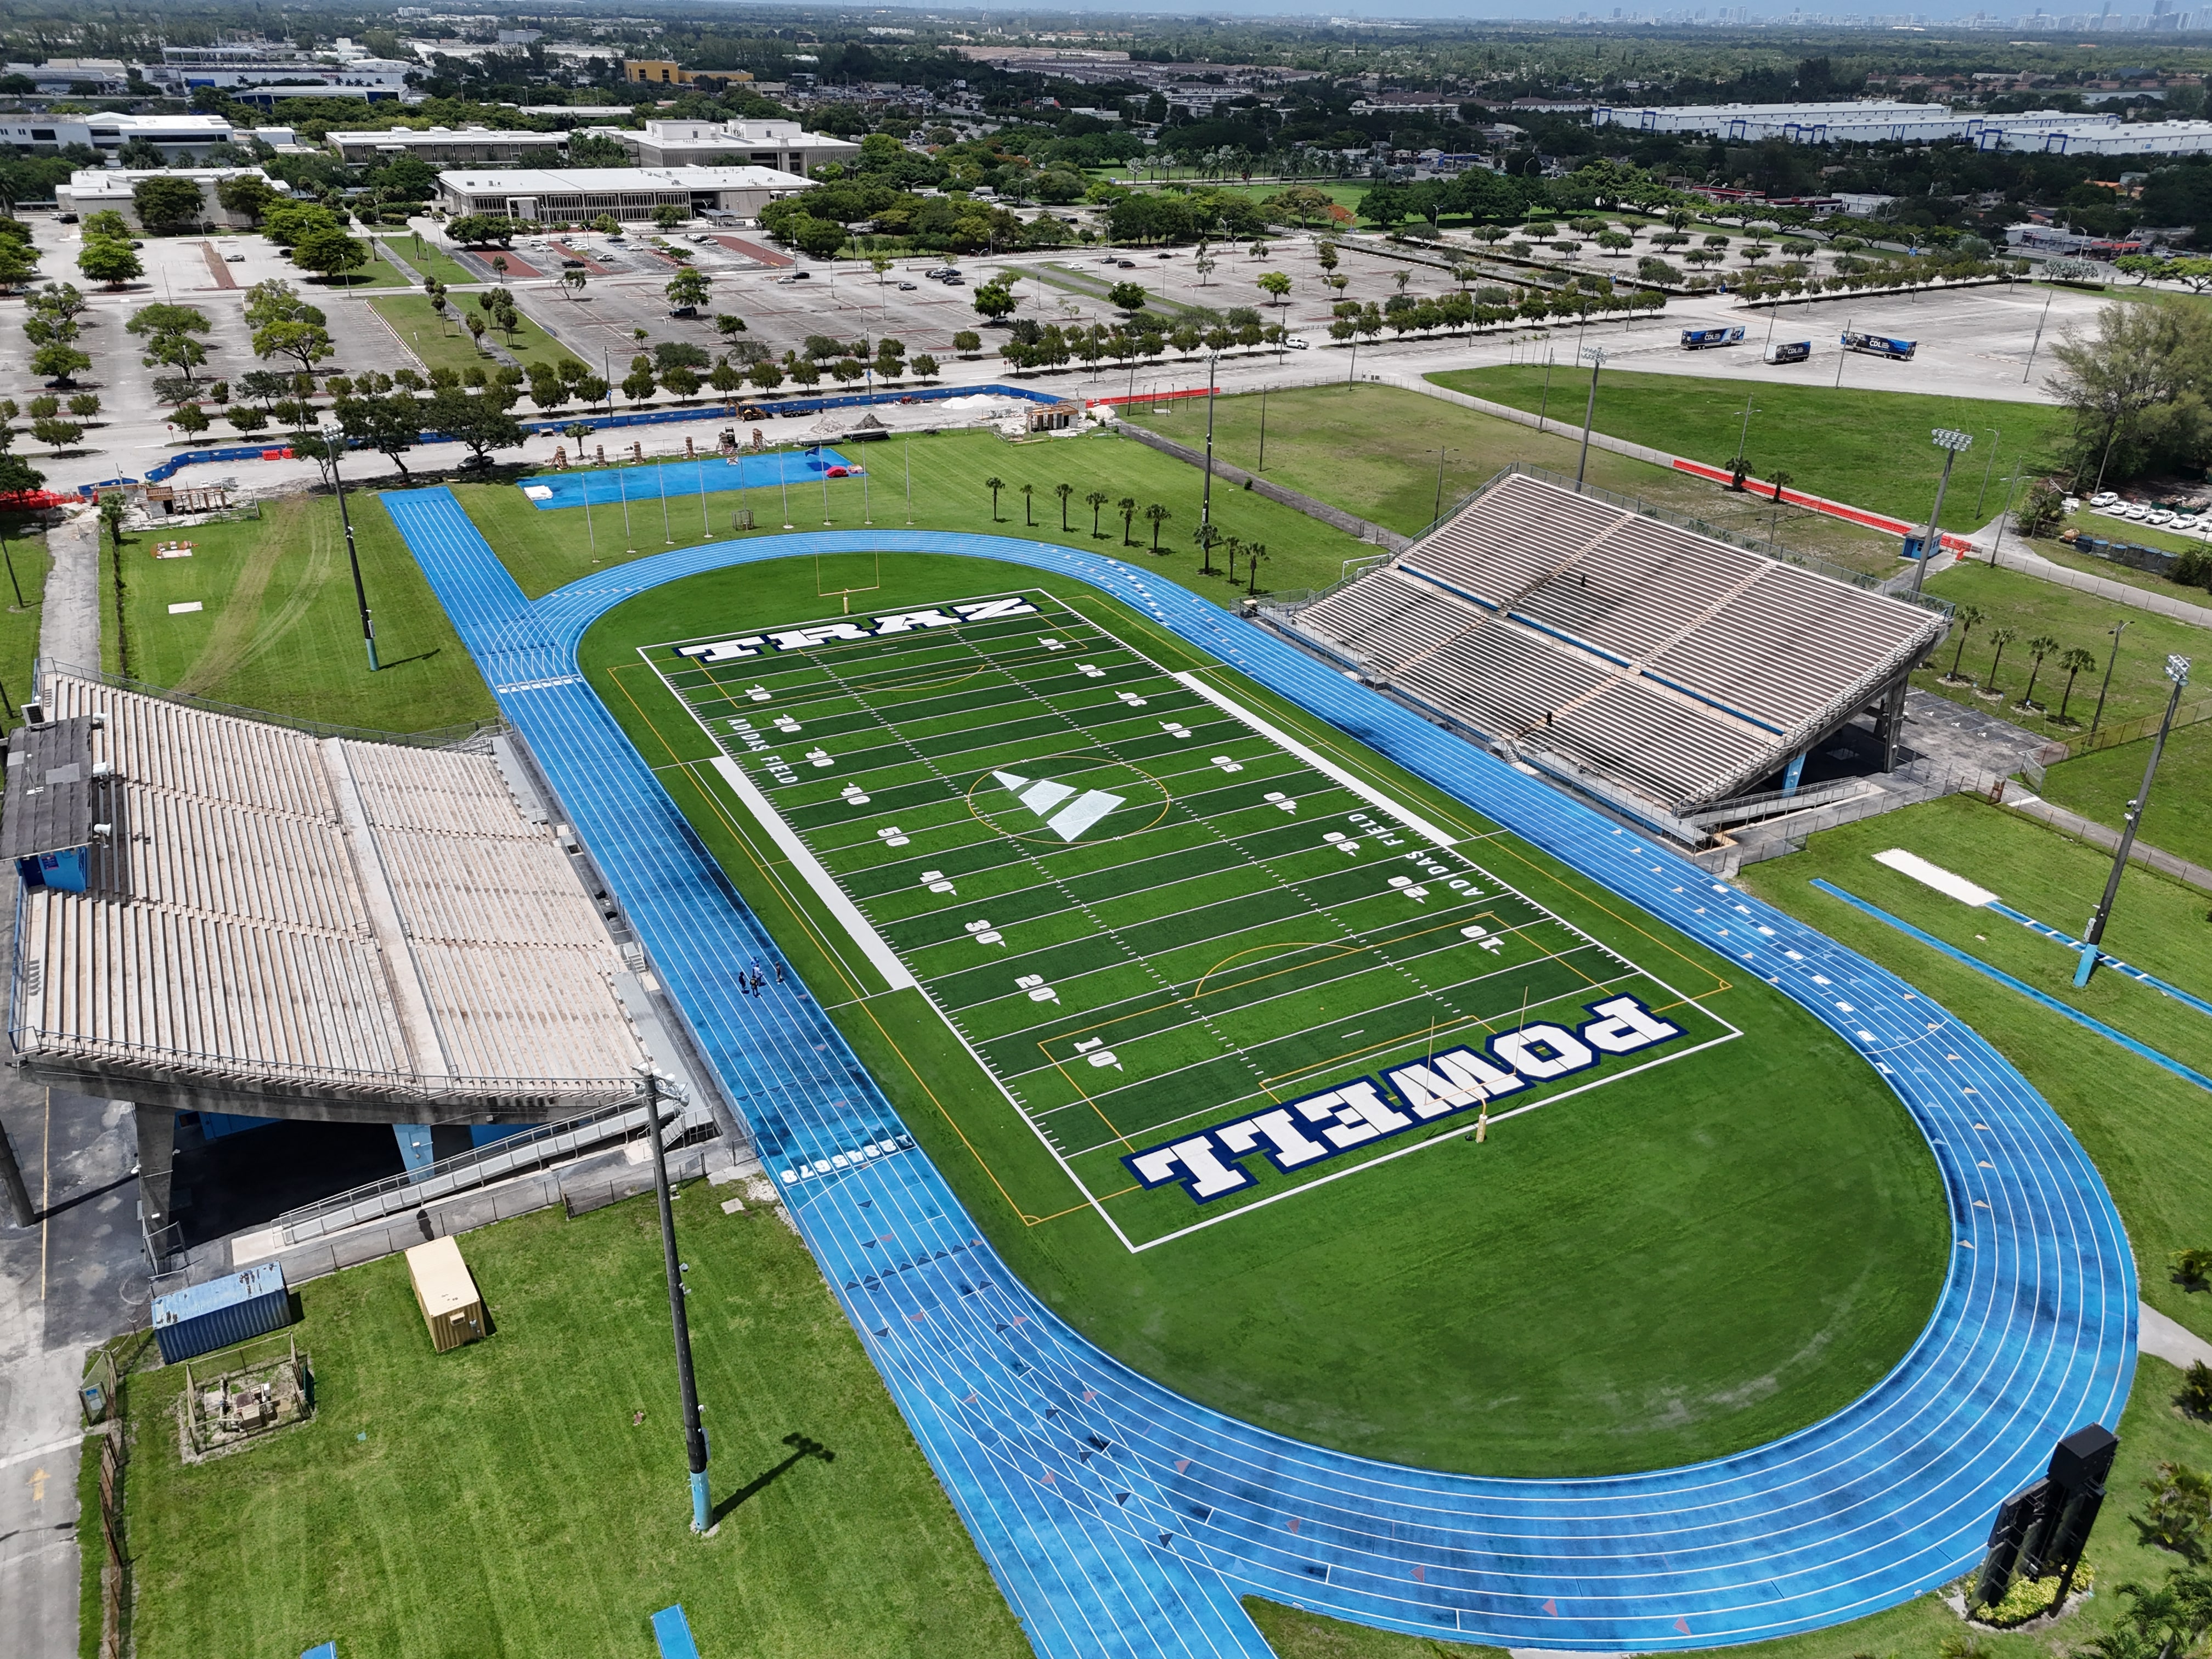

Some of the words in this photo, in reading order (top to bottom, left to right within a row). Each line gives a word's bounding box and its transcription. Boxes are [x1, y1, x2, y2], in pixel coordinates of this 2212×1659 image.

[672, 596, 1042, 663] TRAZ
[1040, 639, 1066, 650] 10
[1077, 664, 1106, 677] 20
[745, 687, 771, 701] 10
[1118, 692, 1147, 706] 30
[773, 718, 802, 732] 20
[1163, 723, 1192, 738] 40
[727, 719, 770, 751] ADIDAS
[760, 755, 798, 783] FIELD
[805, 751, 834, 766] 30
[1211, 756, 1243, 772] 50
[840, 787, 870, 805] 40
[1263, 792, 1296, 810] 40
[877, 827, 910, 846] 50
[1348, 814, 1404, 846] FIELD
[1323, 832, 1360, 851] 30
[919, 870, 953, 893] 40
[1406, 851, 1485, 896] ADIDAS
[1387, 876, 1430, 898] 20
[964, 919, 1002, 944] 30
[1460, 926, 1505, 949] 10
[1014, 974, 1056, 1002] 20
[1073, 1037, 1116, 1067] 10
[1857, 1030, 1876, 1041] 2
[1875, 1062, 1894, 1073] 1
[1119, 992, 1690, 1205] POWELL
[879, 1139, 896, 1152] 2
[895, 1135, 912, 1147] 1
[846, 1150, 864, 1163] 4
[863, 1145, 880, 1157] 3
[814, 1160, 831, 1172] 6
[831, 1154, 849, 1168] 5
[780, 1170, 798, 1183] 8
[799, 1165, 815, 1178] 7
